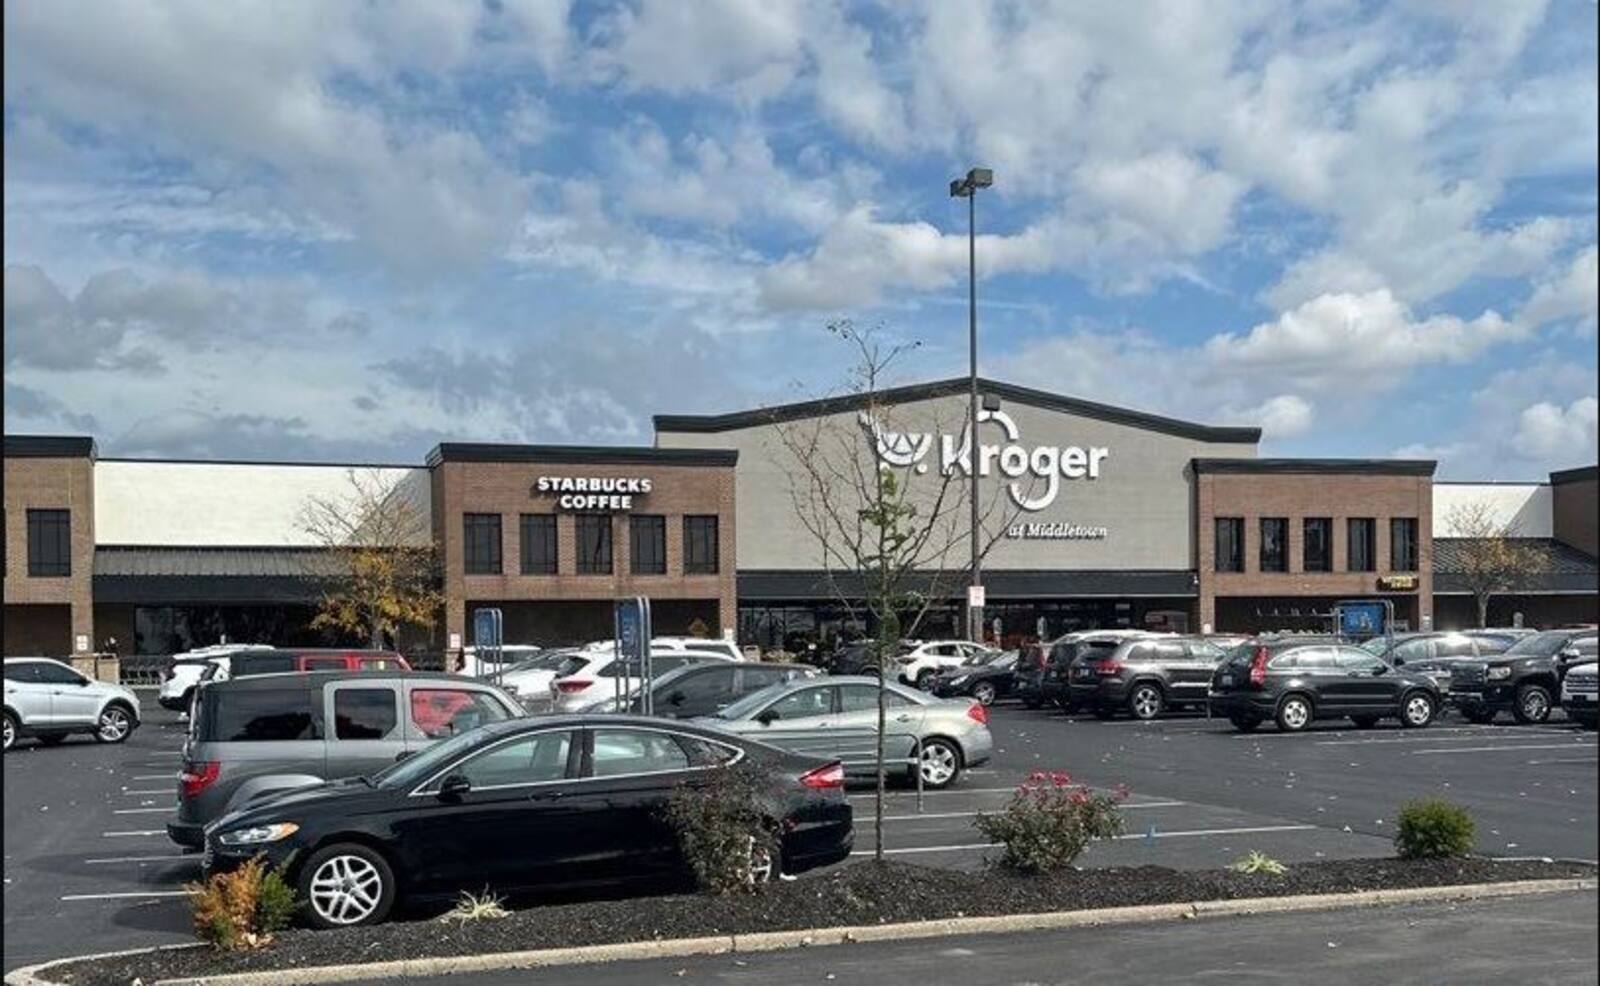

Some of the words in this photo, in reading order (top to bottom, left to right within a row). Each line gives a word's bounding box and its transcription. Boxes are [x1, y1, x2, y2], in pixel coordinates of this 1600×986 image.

[940, 410, 1109, 510] Kroger
[537, 476, 653, 492] STARBUCKS
[560, 495, 633, 509] COFFEE
[1008, 523, 1025, 537] at
[1026, 522, 1107, 537] Middletown
